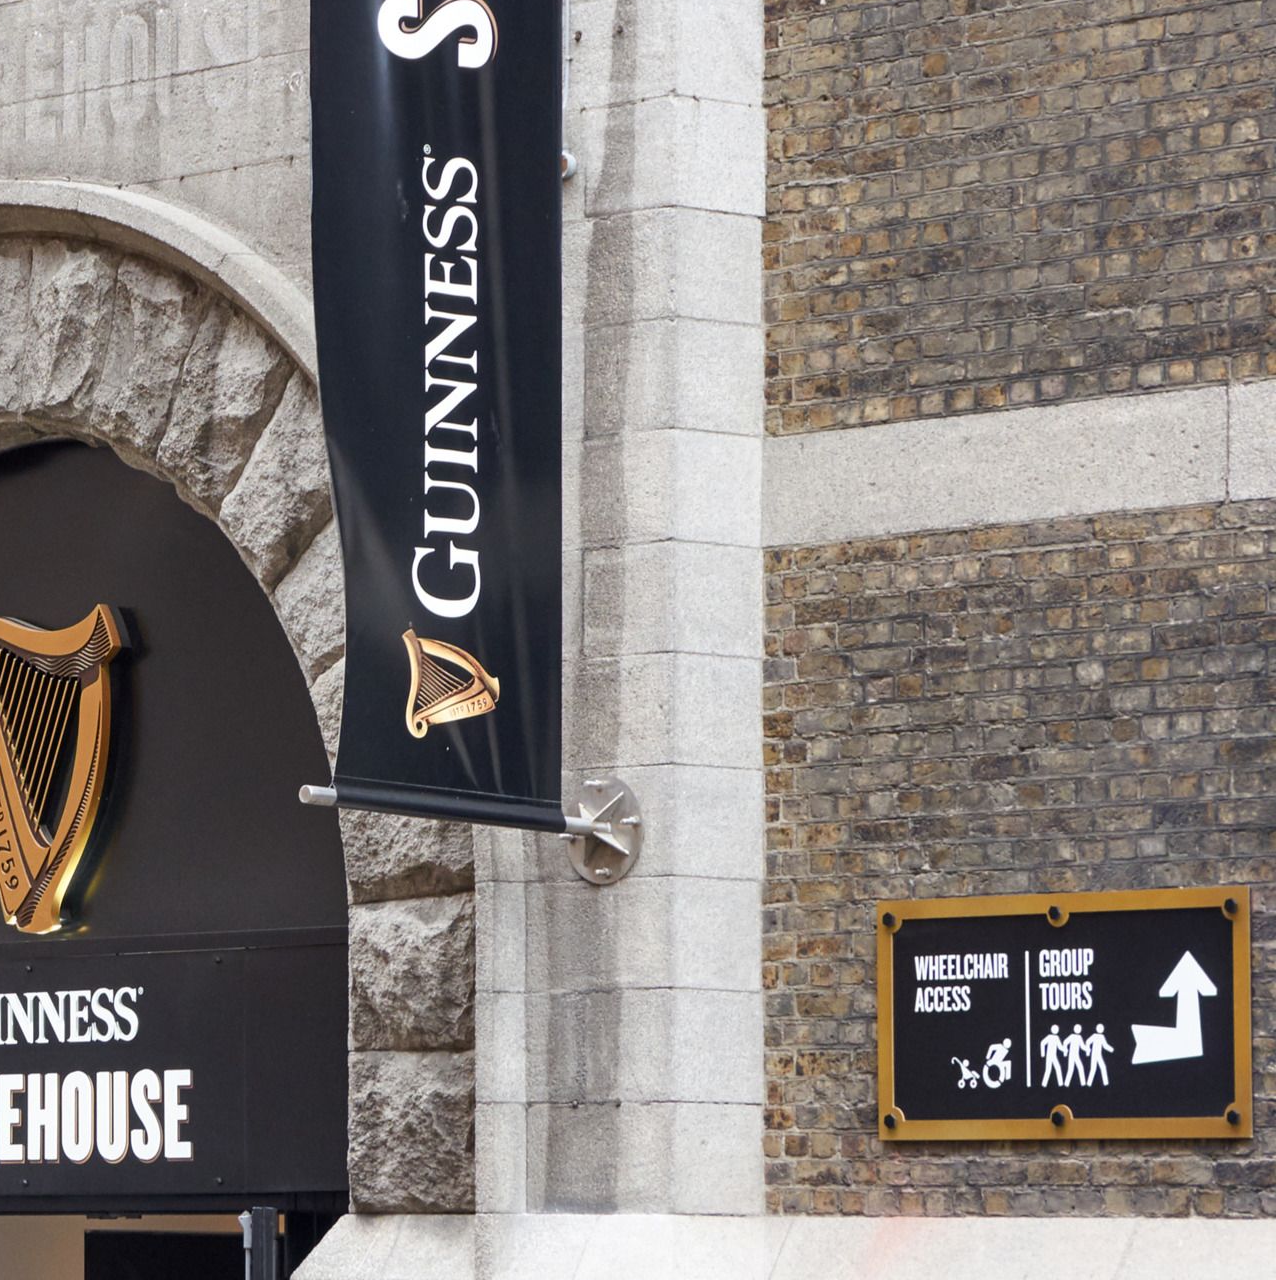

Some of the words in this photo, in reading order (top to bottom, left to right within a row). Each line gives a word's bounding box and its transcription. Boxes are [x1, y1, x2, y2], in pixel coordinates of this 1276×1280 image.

[411, 156, 481, 618] GUINNESS
[466, 697, 488, 713] 1759
[914, 953, 1009, 981] WHEELCHAIR
[1039, 948, 1094, 977] GROUP
[914, 986, 971, 1012] ACCESS
[1039, 981, 1093, 1010] TOURS
